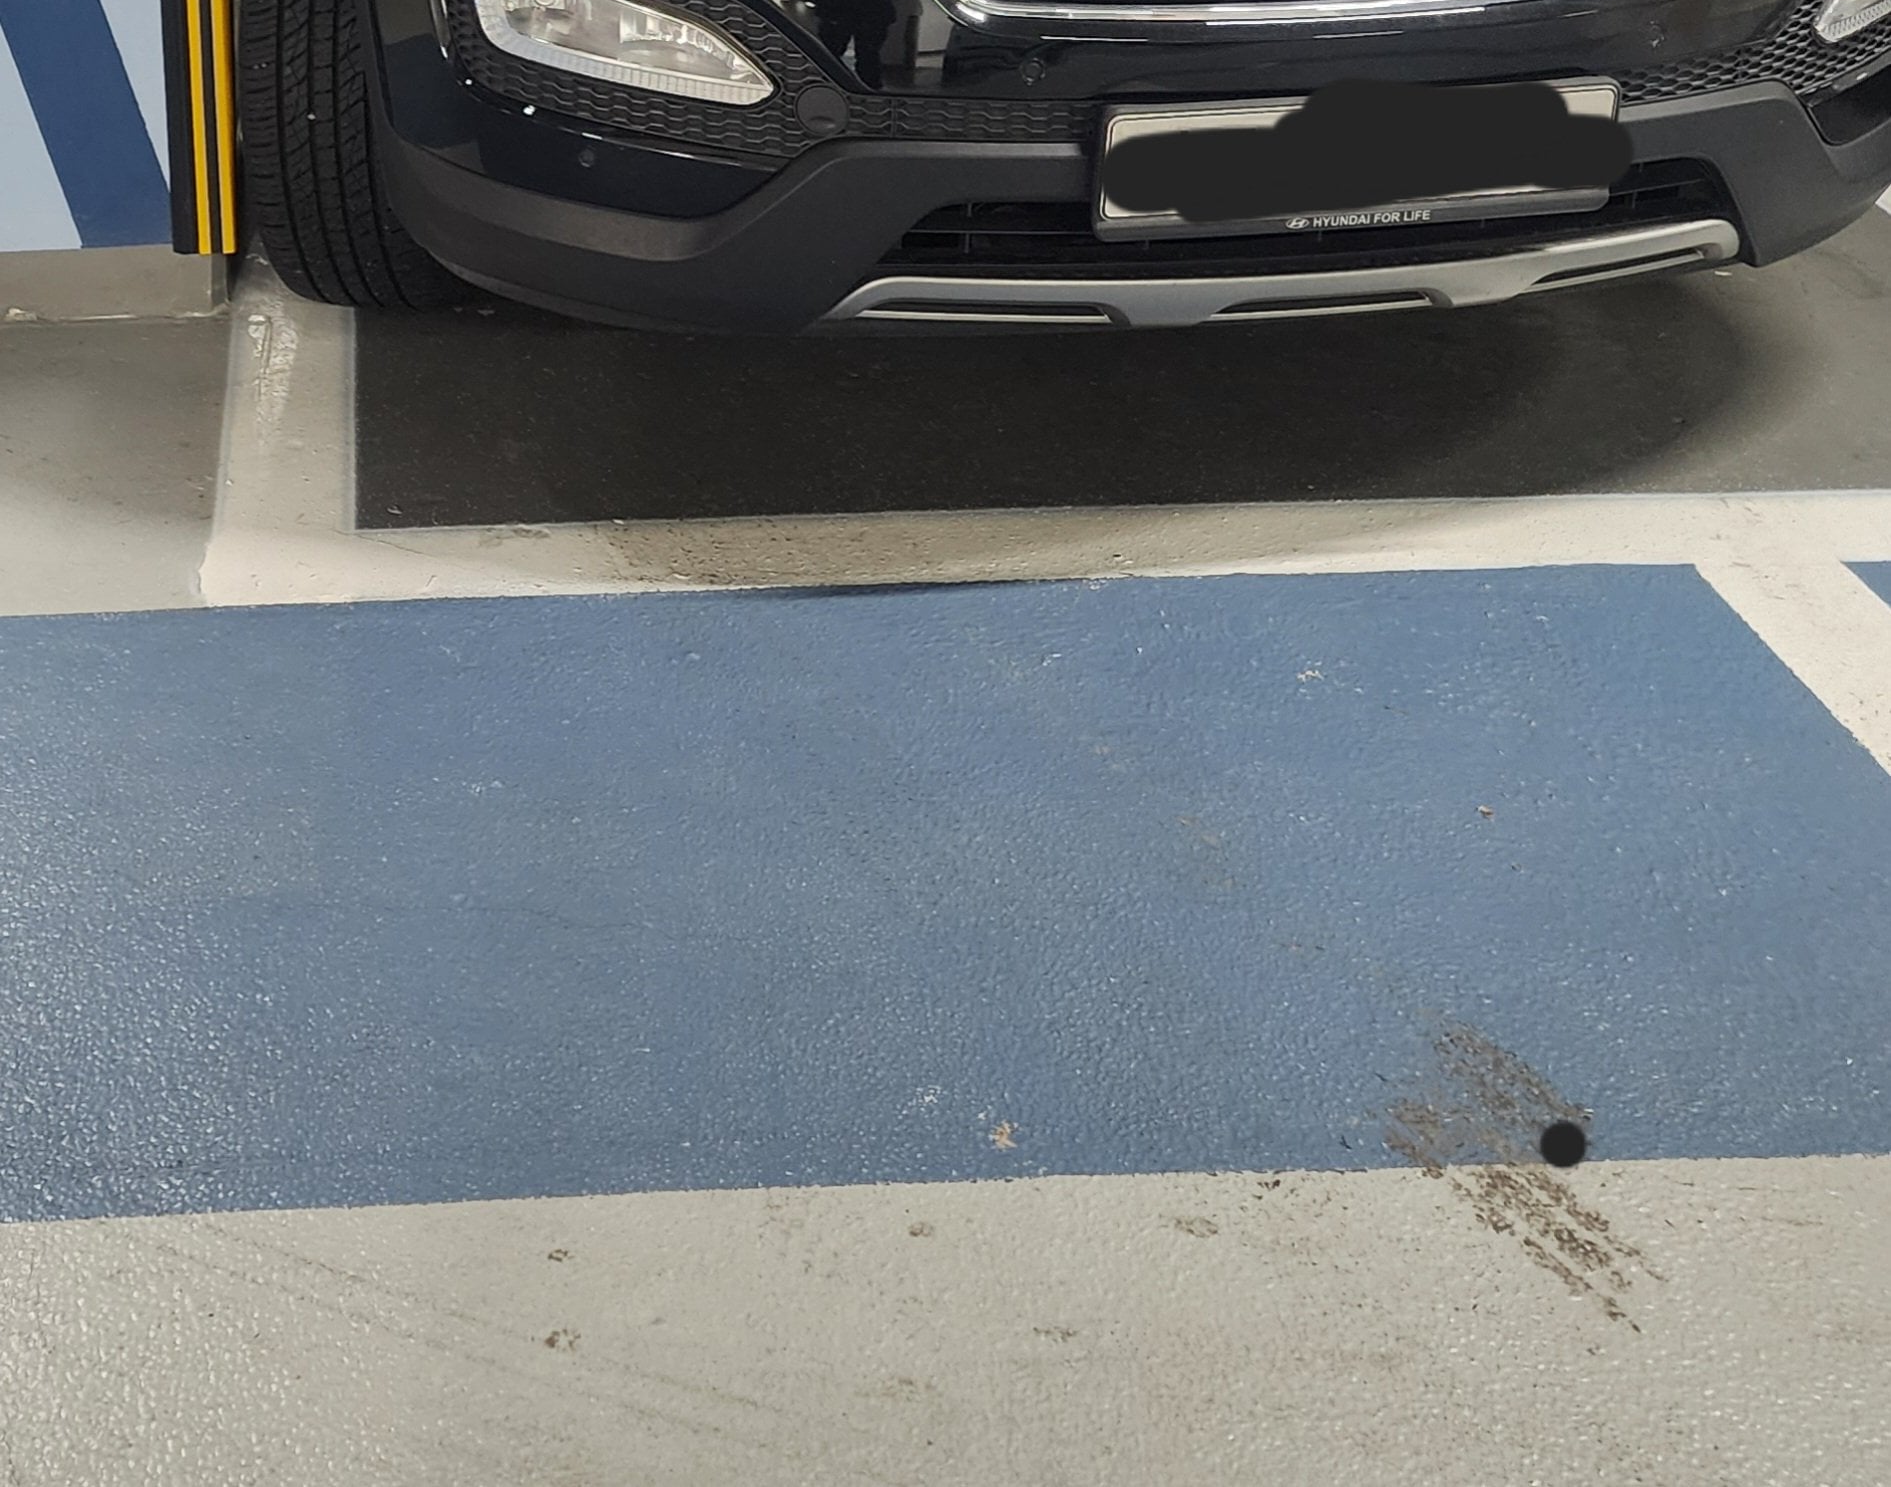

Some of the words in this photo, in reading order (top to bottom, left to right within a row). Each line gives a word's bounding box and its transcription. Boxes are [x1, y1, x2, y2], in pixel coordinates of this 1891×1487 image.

[1312, 214, 1371, 228] HYUNDAI
[1373, 212, 1400, 224] FOR
[1403, 209, 1431, 222] LIFE
